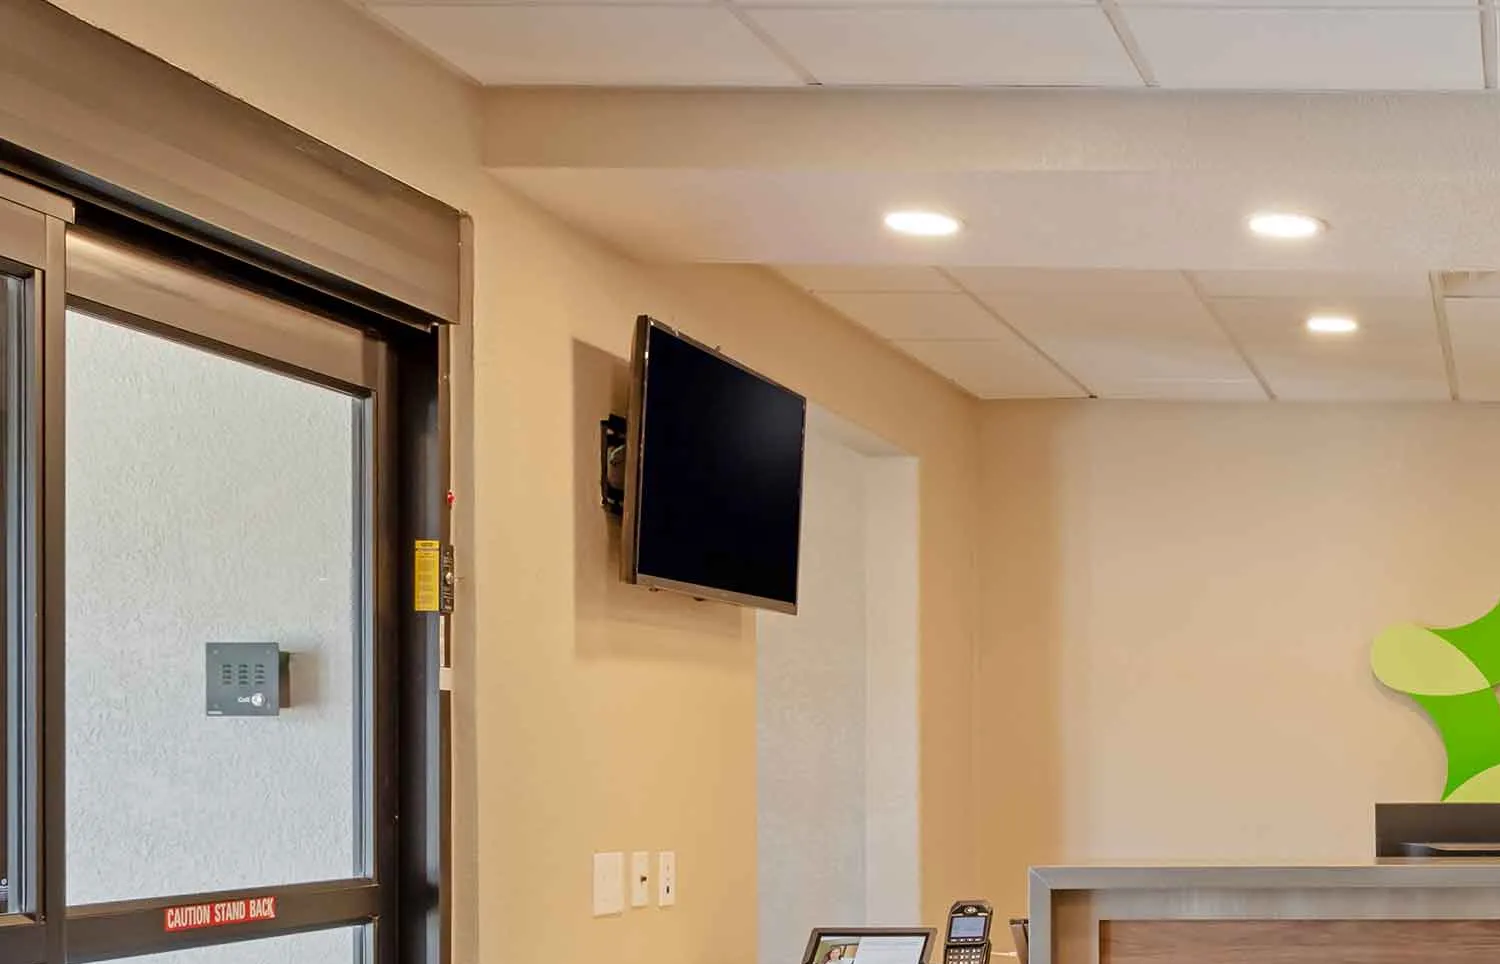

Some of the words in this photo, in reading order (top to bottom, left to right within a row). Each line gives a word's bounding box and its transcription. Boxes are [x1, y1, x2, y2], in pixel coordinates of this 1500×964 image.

[167, 905, 211, 929] CAUTION
[214, 901, 246, 922] STAND
[249, 897, 275, 918] BACK
